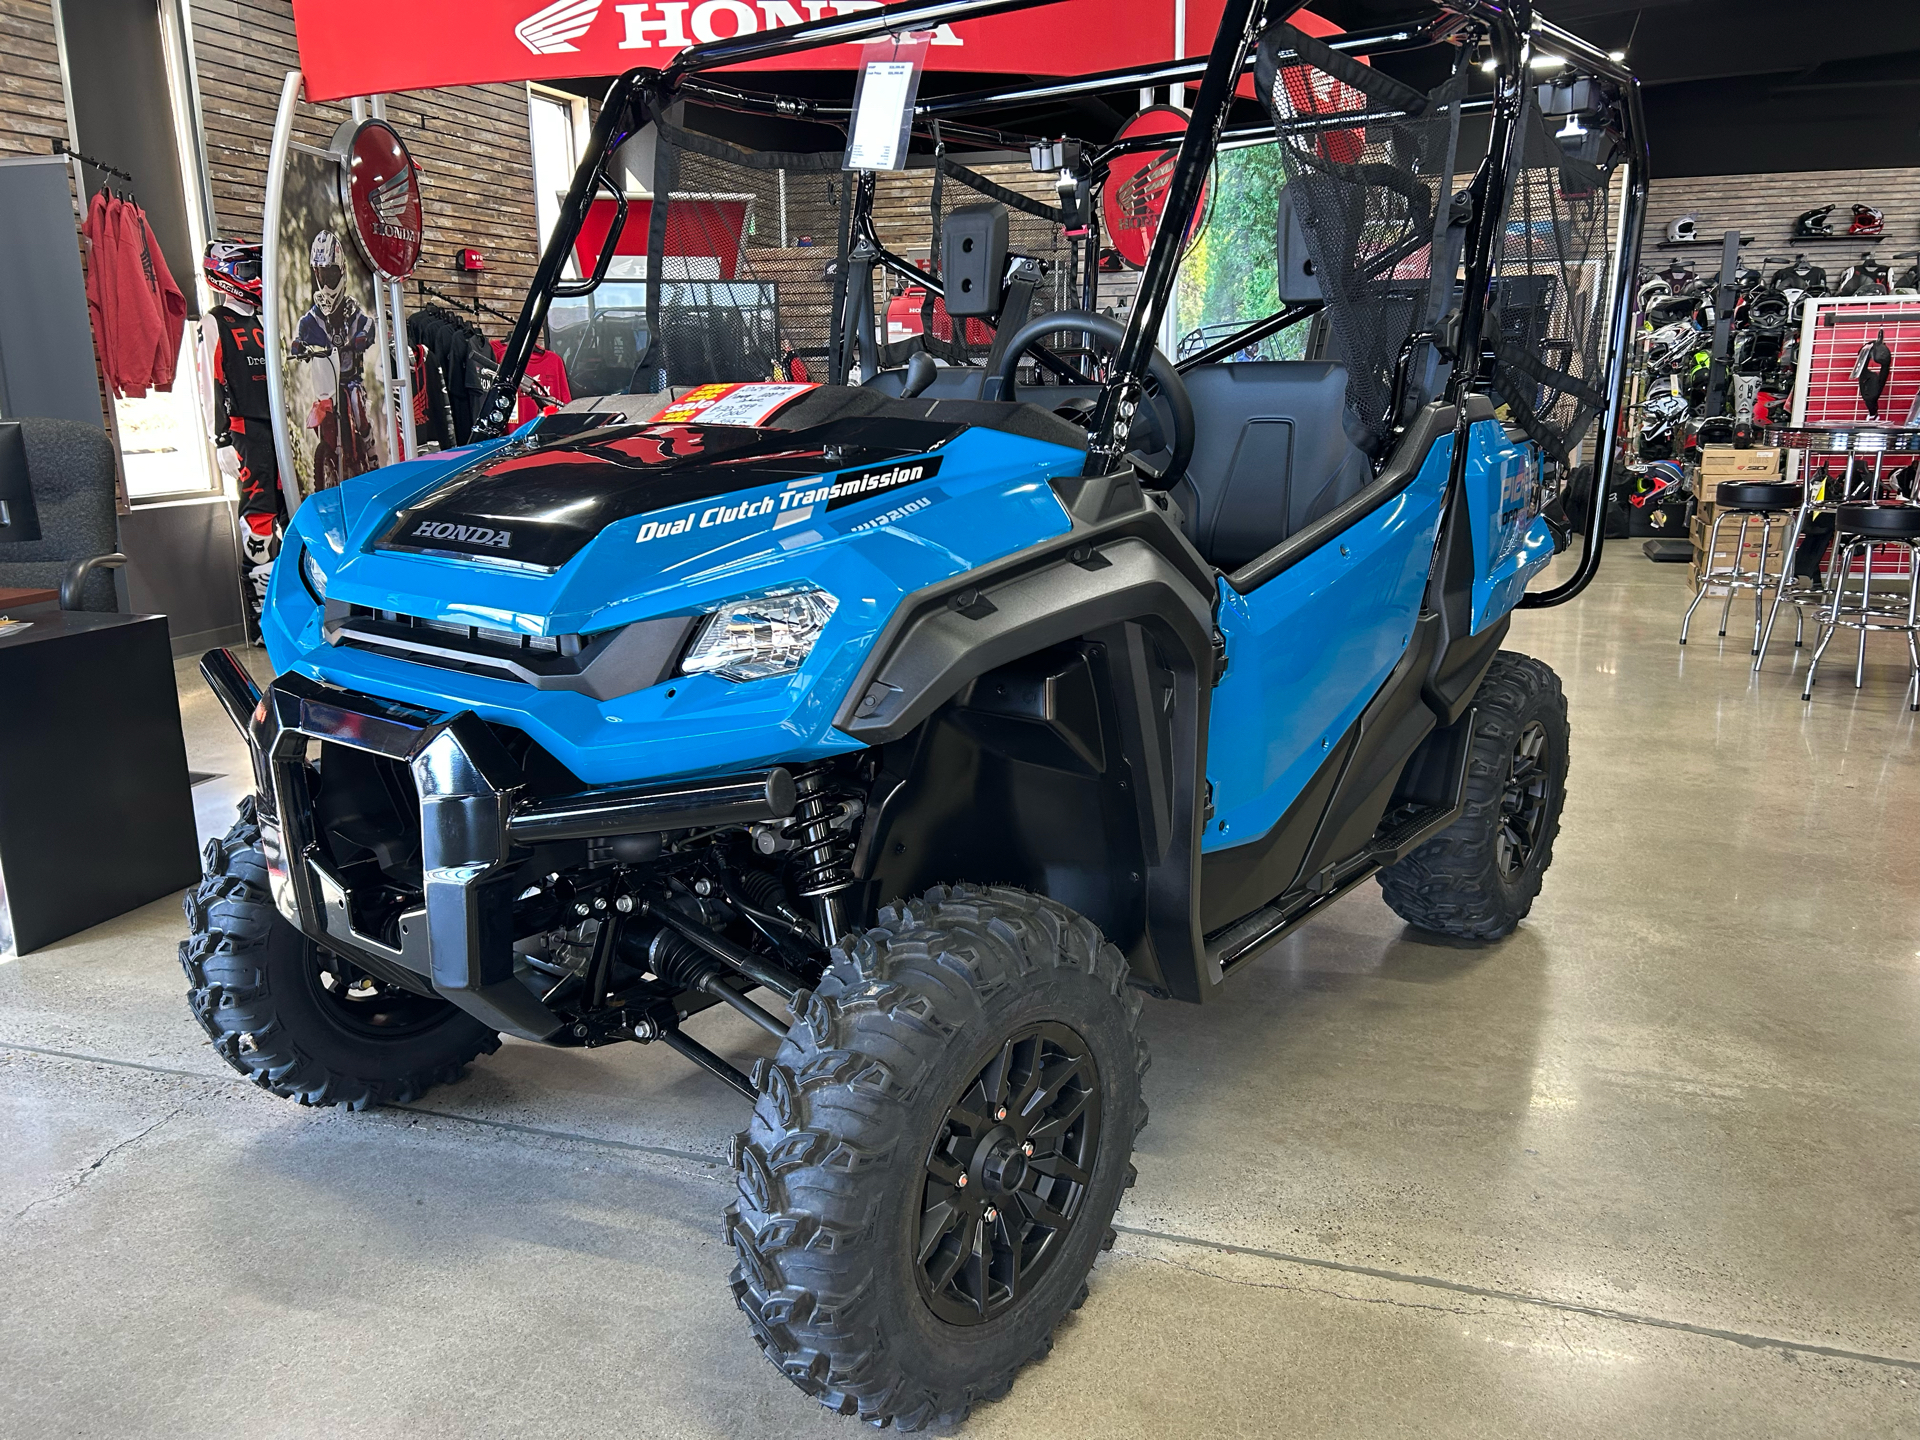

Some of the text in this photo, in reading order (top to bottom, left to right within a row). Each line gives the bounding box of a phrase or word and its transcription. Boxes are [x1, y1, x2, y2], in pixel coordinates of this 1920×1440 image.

[372, 221, 416, 242] HONDA
[208, 274, 244, 297] FOX RACING
[231, 328, 265, 351] FO
[247, 356, 266, 366] Dre
[665, 399, 716, 413] sale
[636, 466, 924, 543] Dual Clutch Transmission
[412, 521, 511, 547] HONDA
